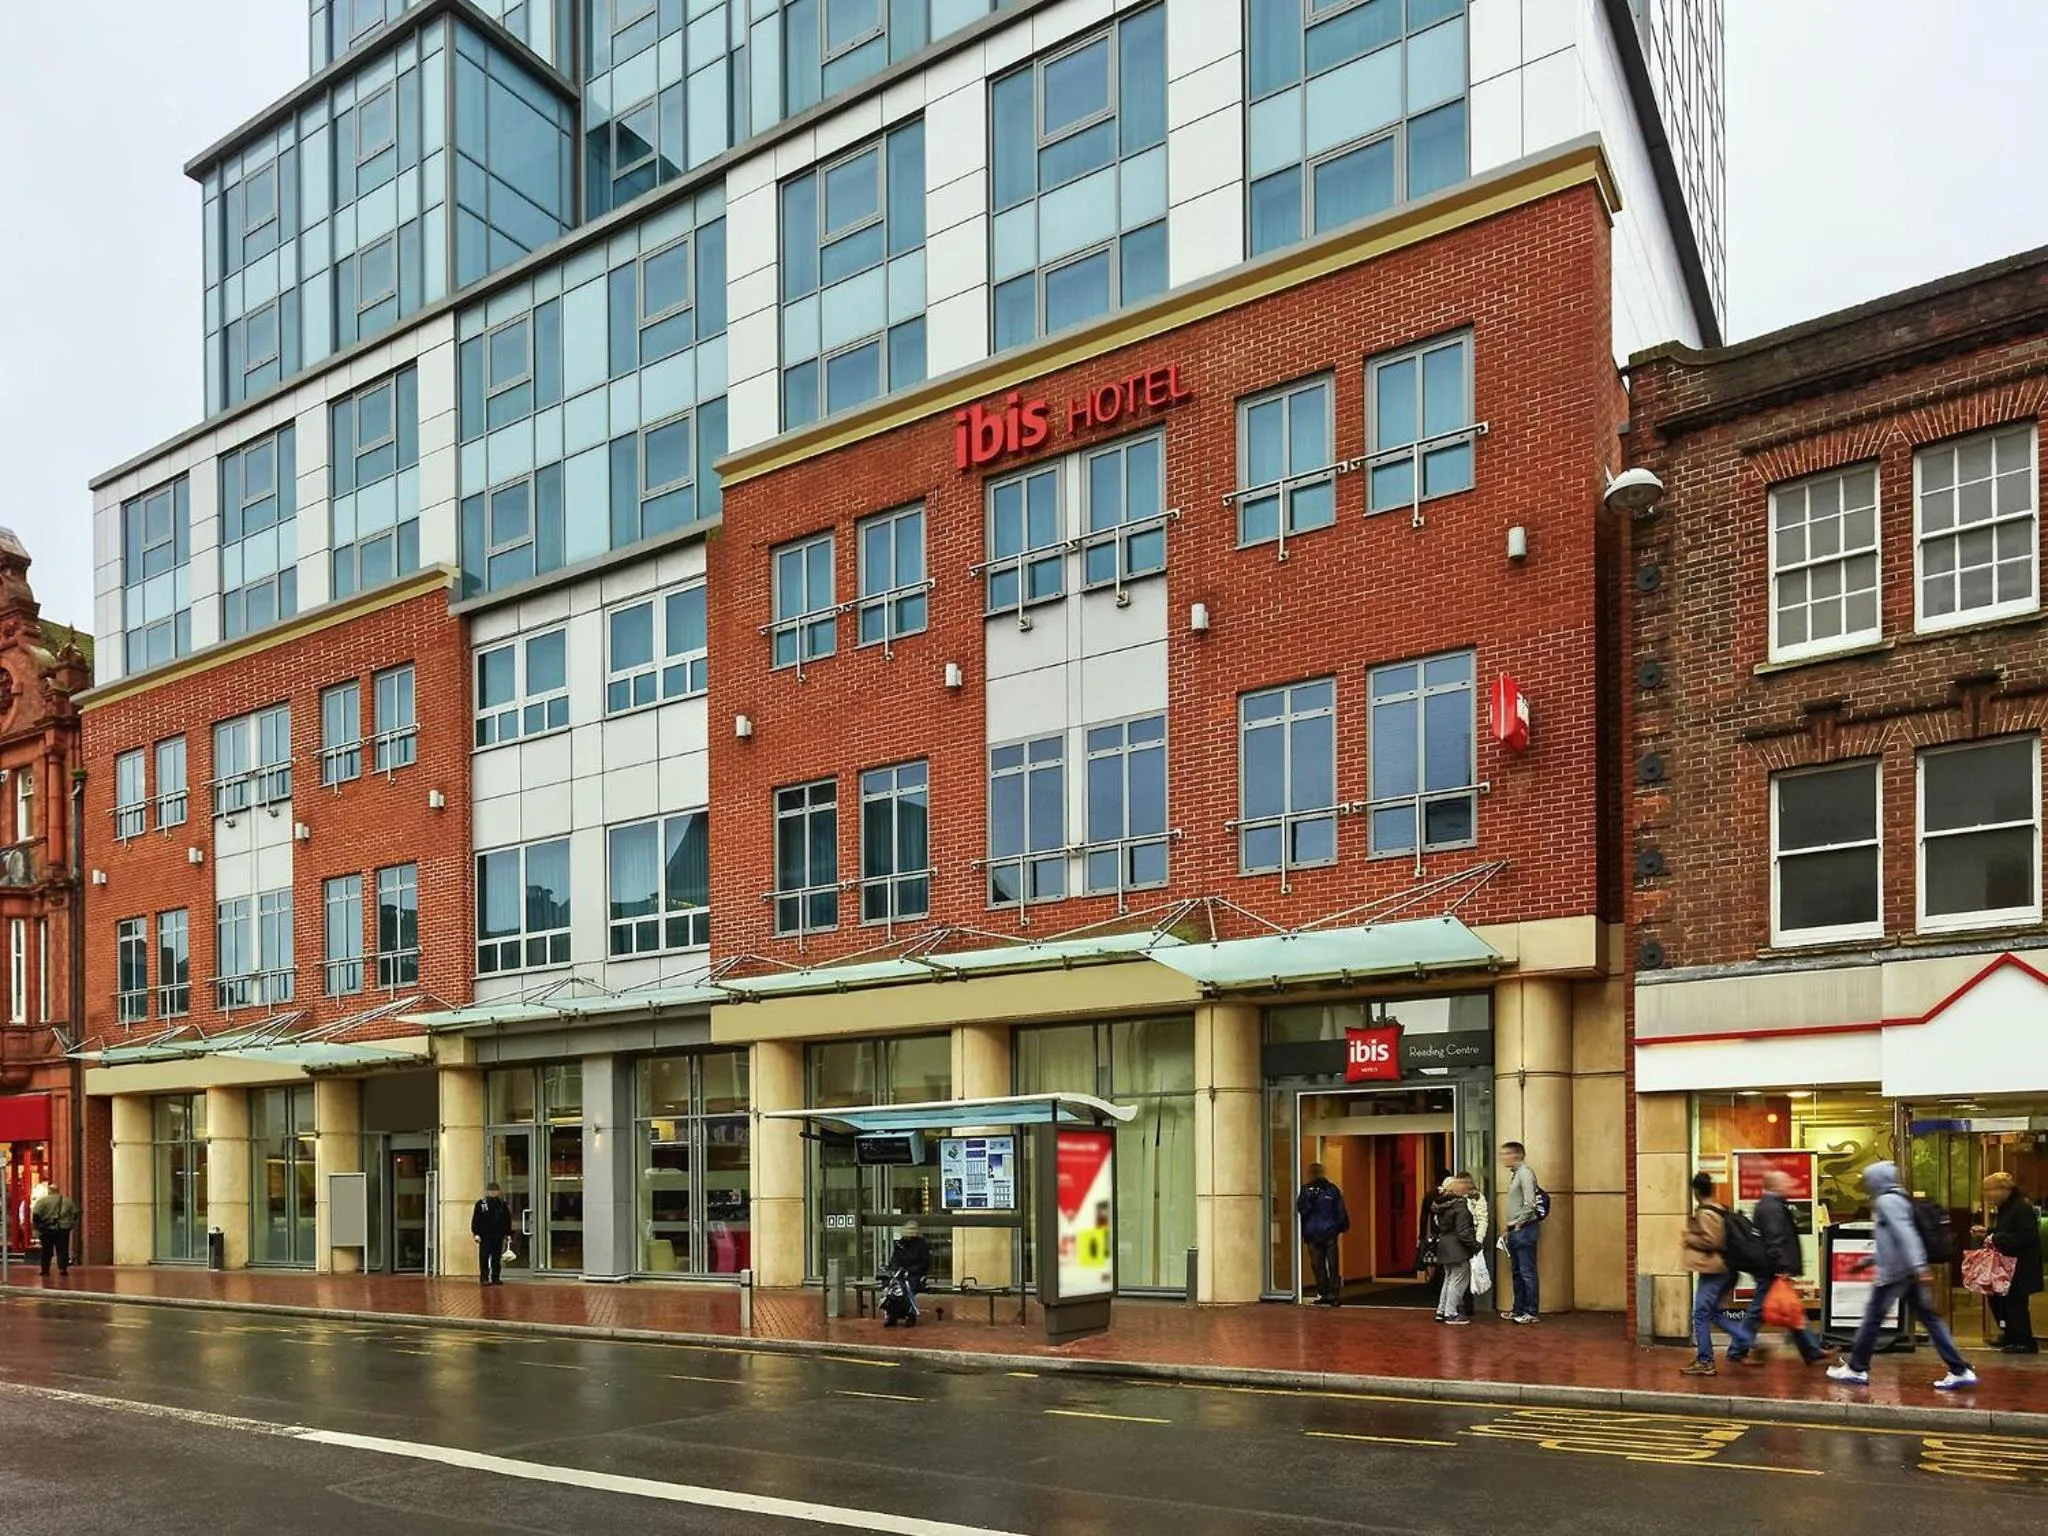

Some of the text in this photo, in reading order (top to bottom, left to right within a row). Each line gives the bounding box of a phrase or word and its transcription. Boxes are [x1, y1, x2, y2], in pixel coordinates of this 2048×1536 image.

[954, 363, 1192, 470] ibis HOTEL
[1349, 1039, 1390, 1063] ibis
[1408, 1044, 1480, 1058] Reading Centre
